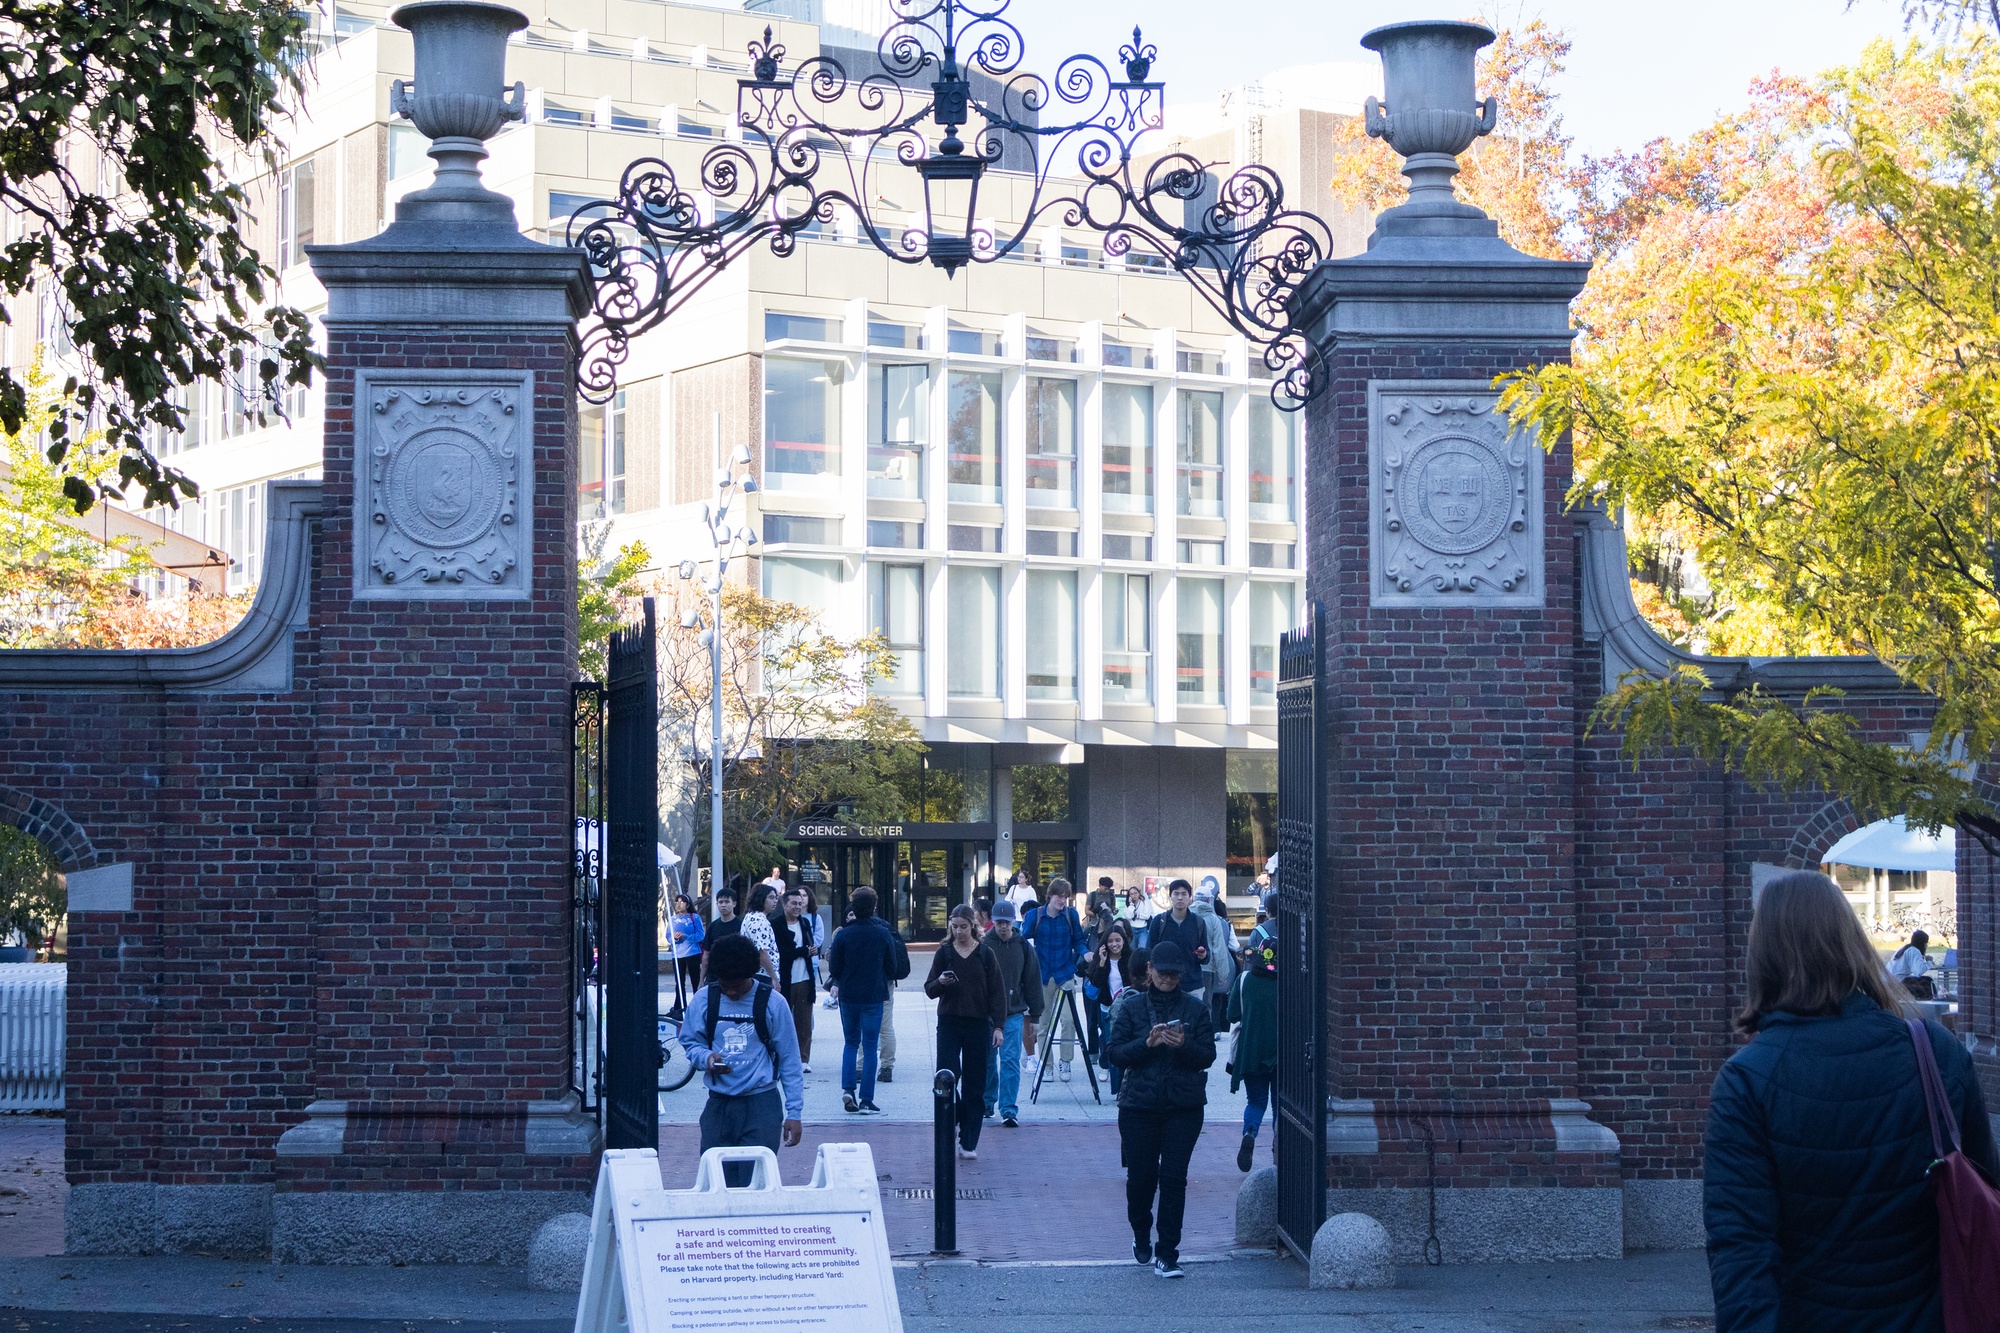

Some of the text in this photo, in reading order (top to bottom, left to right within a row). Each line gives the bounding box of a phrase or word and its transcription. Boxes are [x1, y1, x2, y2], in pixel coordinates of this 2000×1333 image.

[937, 91, 963, 114] 79
[799, 826, 847, 836] SCIENCE
[677, 1228, 714, 1237] Harvard
[728, 1226, 778, 1235] committed
[794, 1225, 831, 1234] creating
[726, 1238, 776, 1247] welcoming
[779, 1237, 836, 1245] environment
[688, 1251, 731, 1260] members
[764, 1249, 800, 1257] Harvard
[804, 1247, 857, 1256] community.
[823, 1260, 860, 1268] prohibited
